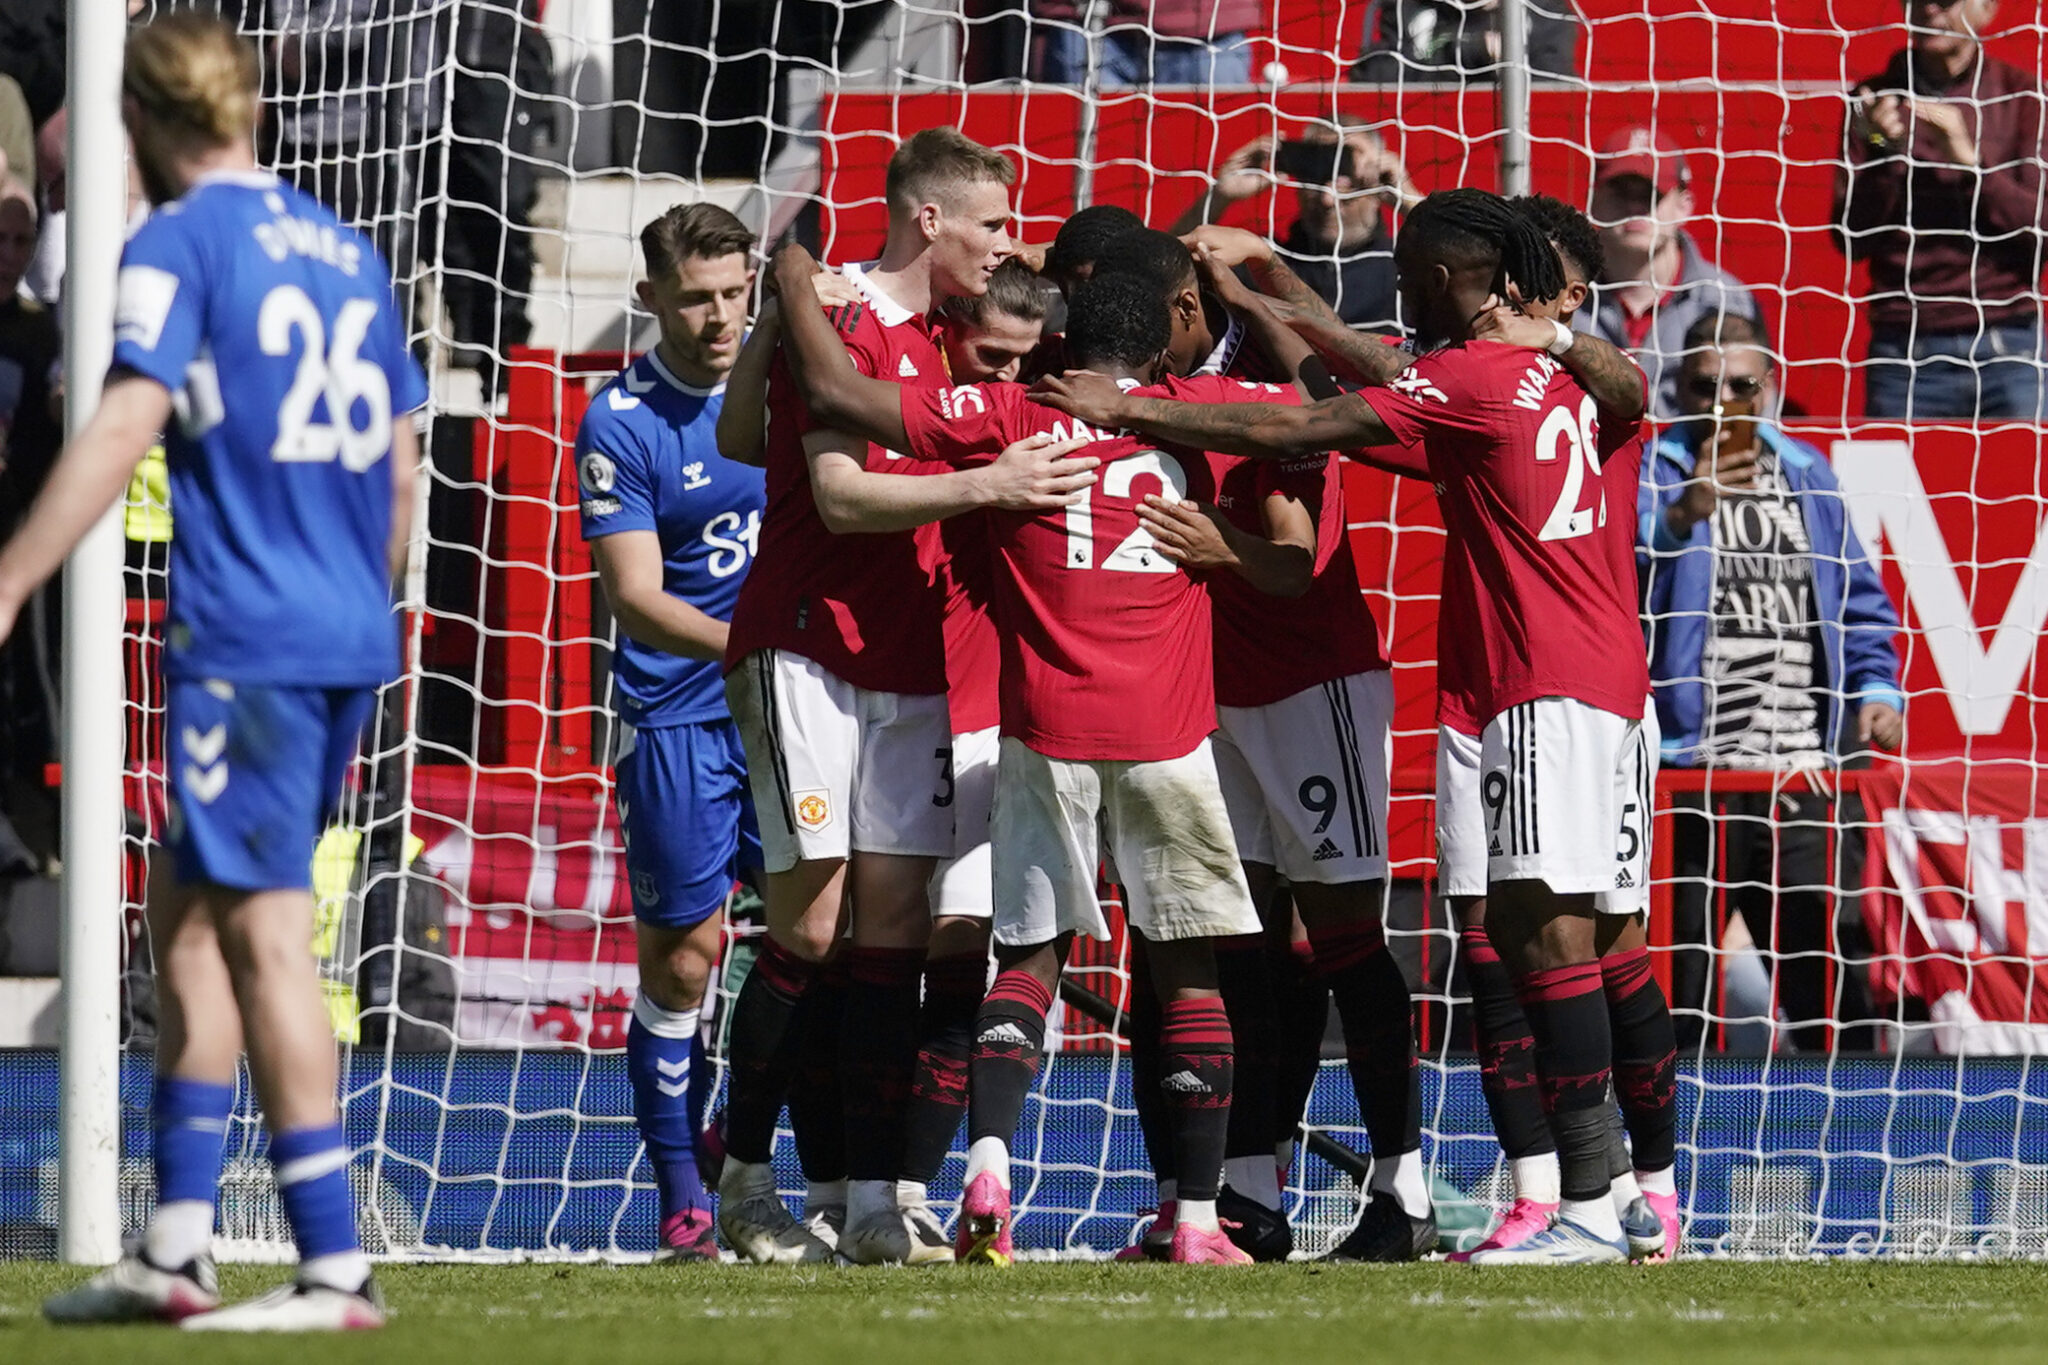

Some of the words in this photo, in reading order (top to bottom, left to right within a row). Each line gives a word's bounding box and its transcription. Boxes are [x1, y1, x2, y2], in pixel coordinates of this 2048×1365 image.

[257, 284, 391, 473] 26
[1064, 450, 1187, 573] 12
[932, 748, 955, 808] 3
[1298, 775, 1338, 834] 9
[1484, 771, 1507, 831] 9
[1616, 803, 1639, 863] 5
[976, 1033, 1035, 1050] adidas
